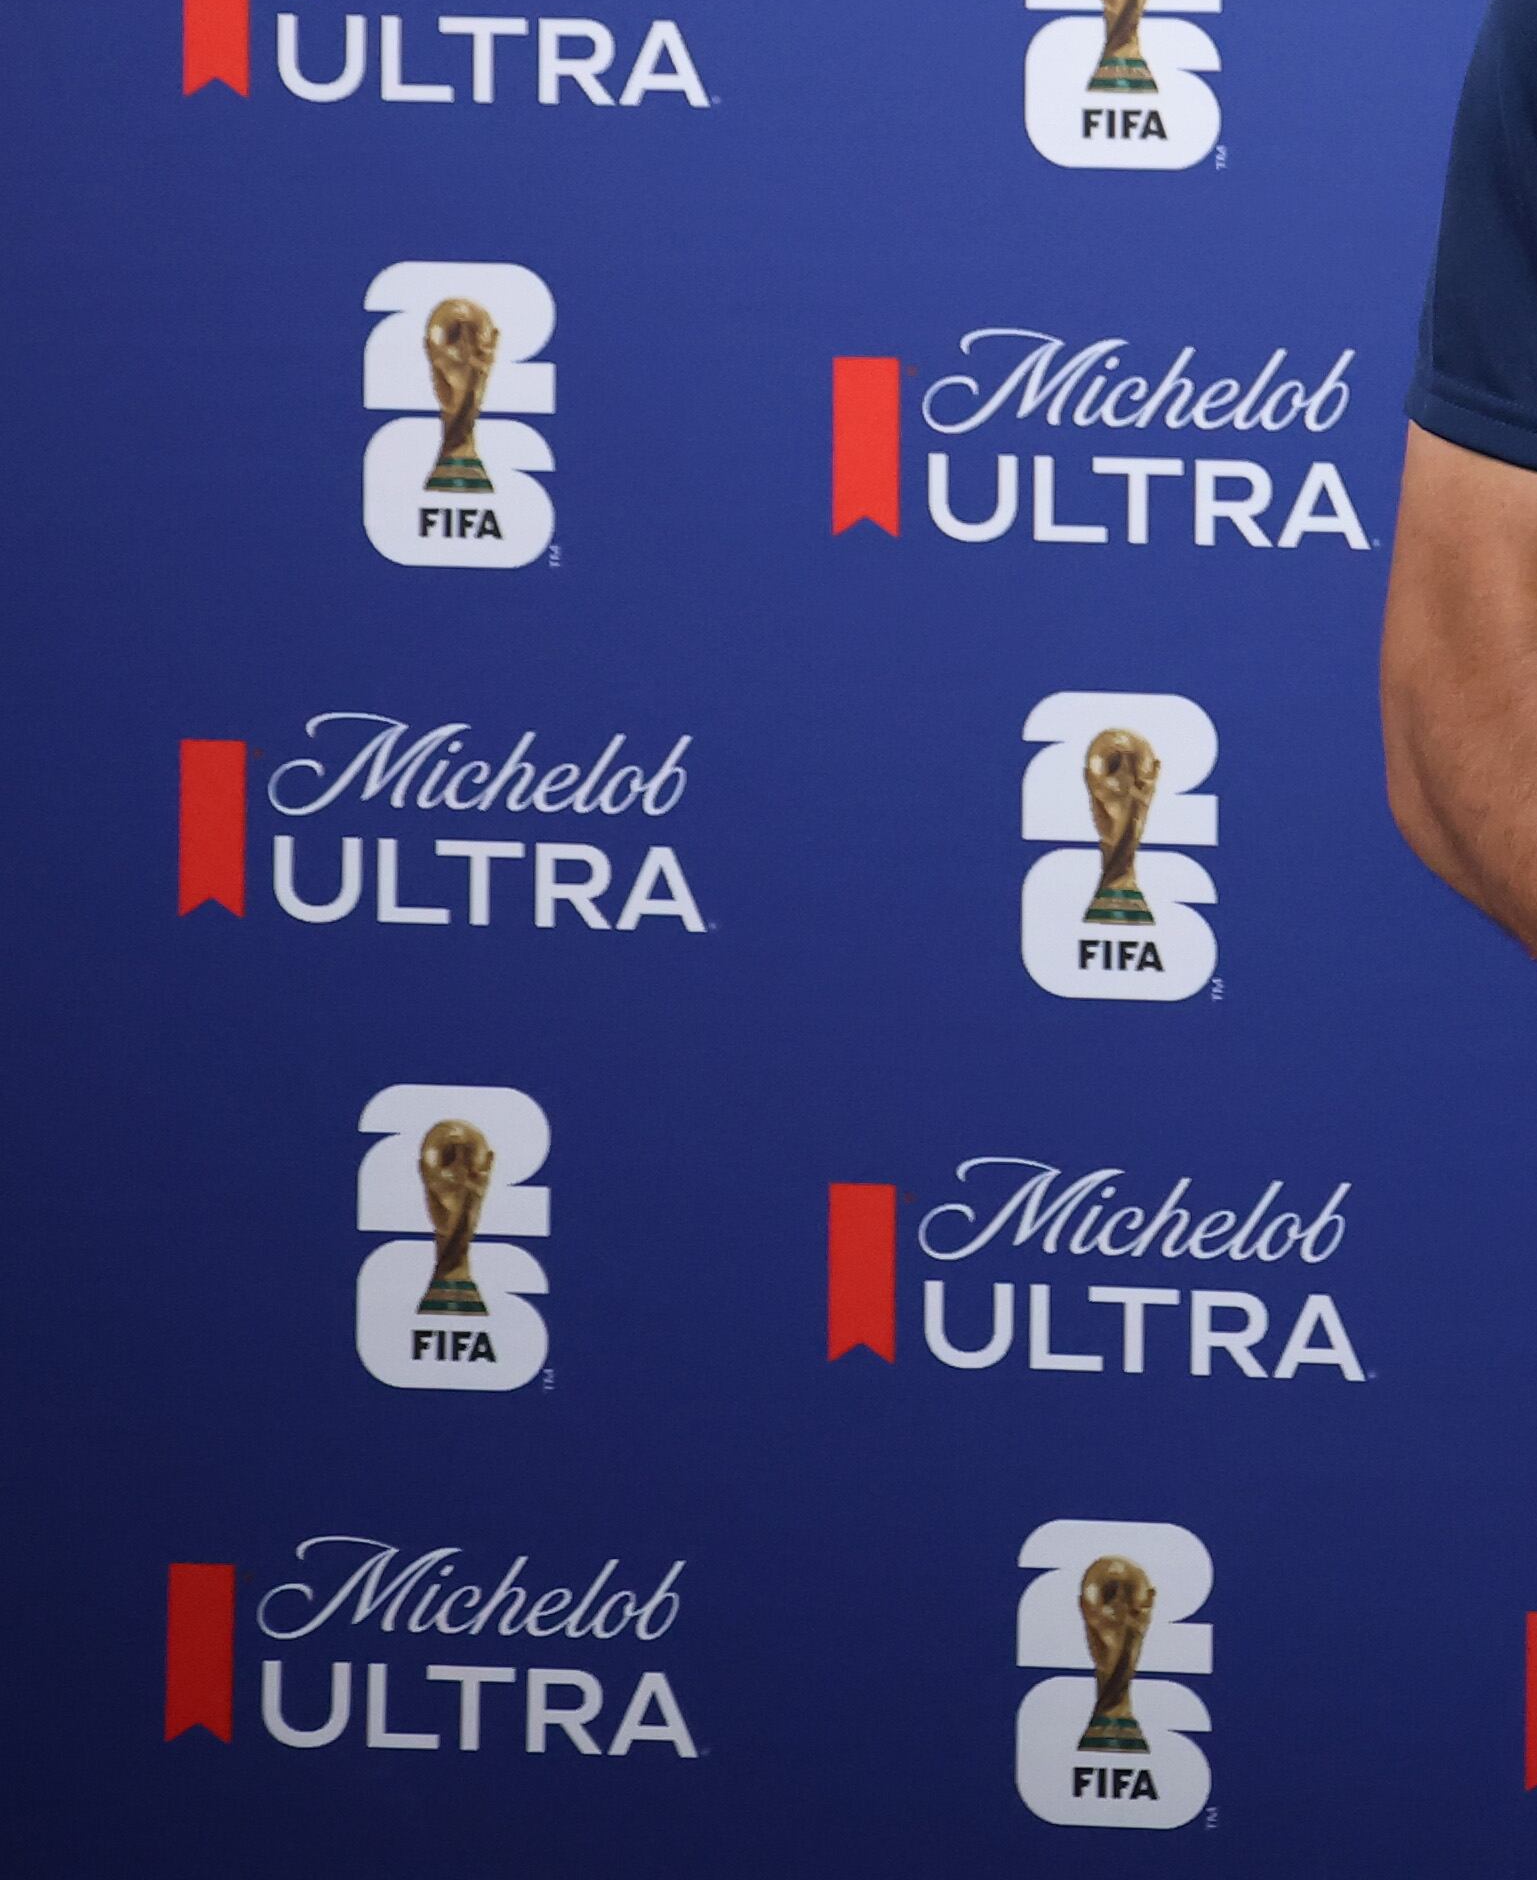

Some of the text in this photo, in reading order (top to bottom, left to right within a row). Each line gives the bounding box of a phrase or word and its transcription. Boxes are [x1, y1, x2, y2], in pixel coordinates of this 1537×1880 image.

[278, 14, 710, 107] ULTRA
[1082, 109, 1167, 140] FIFA
[922, 328, 1355, 433] Michelob
[419, 507, 502, 540] FIFA
[928, 453, 1371, 550] ULTRA
[268, 712, 693, 815] Michelob
[274, 835, 707, 932] ULTRA
[1078, 939, 1164, 972] FIFA
[919, 1157, 1351, 1263] Michelob
[412, 1329, 497, 1363] FIFA
[924, 1280, 1365, 1381] ULTRA
[258, 1536, 686, 1640] Michelob
[262, 1660, 698, 1758] ULTRA
[1072, 1766, 1159, 1801] FIFA
